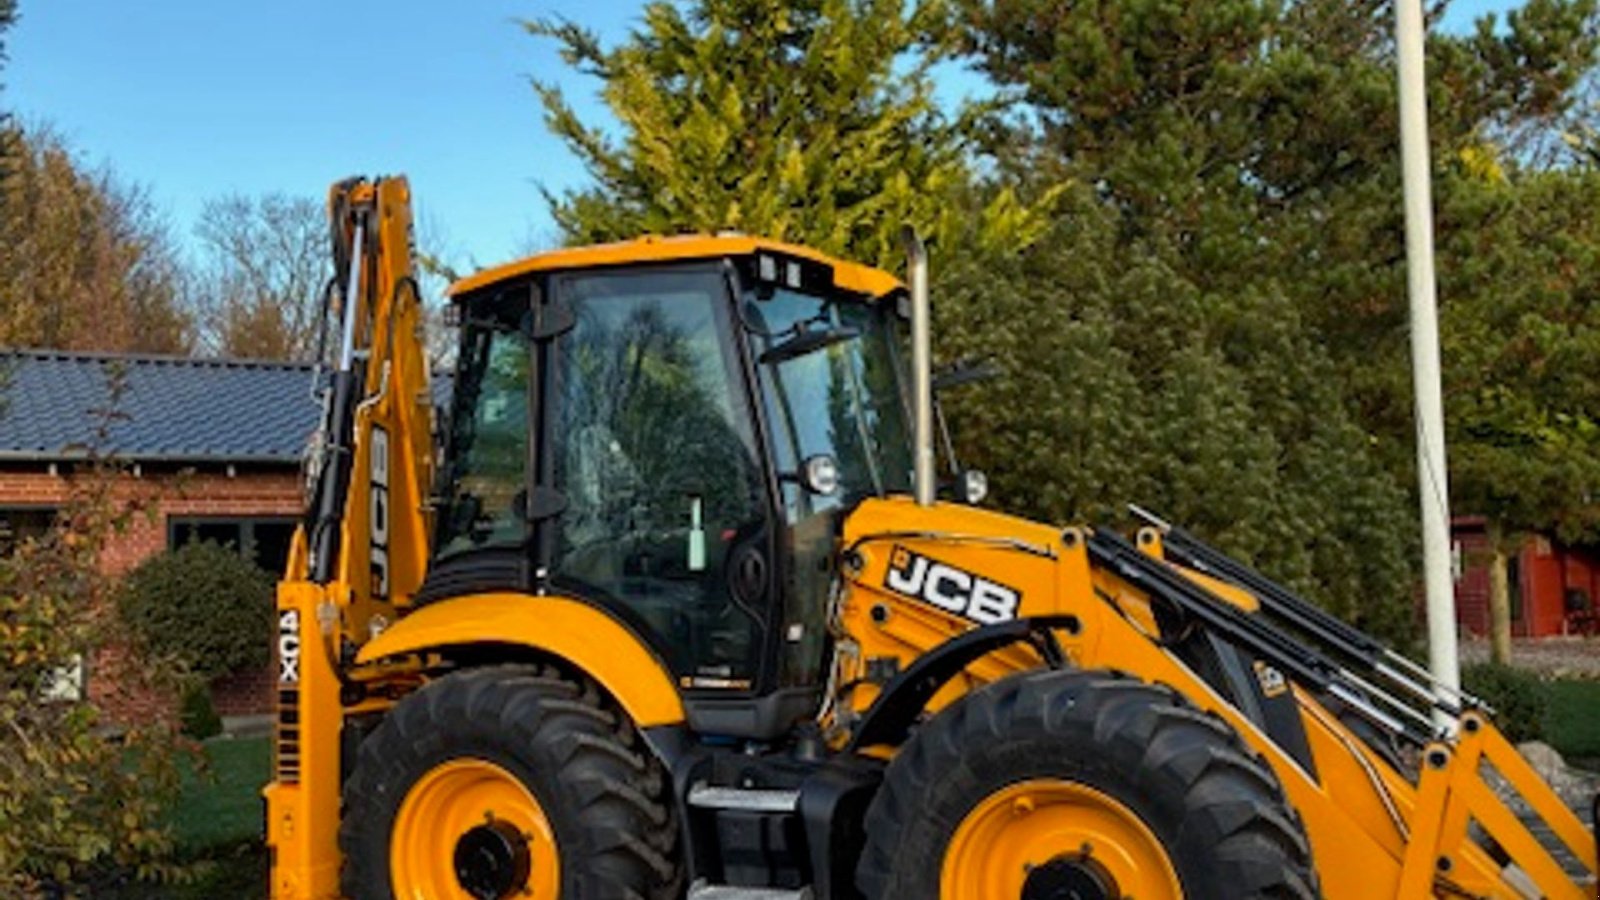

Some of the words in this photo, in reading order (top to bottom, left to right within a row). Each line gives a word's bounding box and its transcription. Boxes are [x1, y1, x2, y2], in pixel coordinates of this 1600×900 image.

[370, 427, 389, 598] JCB
[888, 556, 1018, 625] JCB
[279, 610, 300, 682] 4CX
